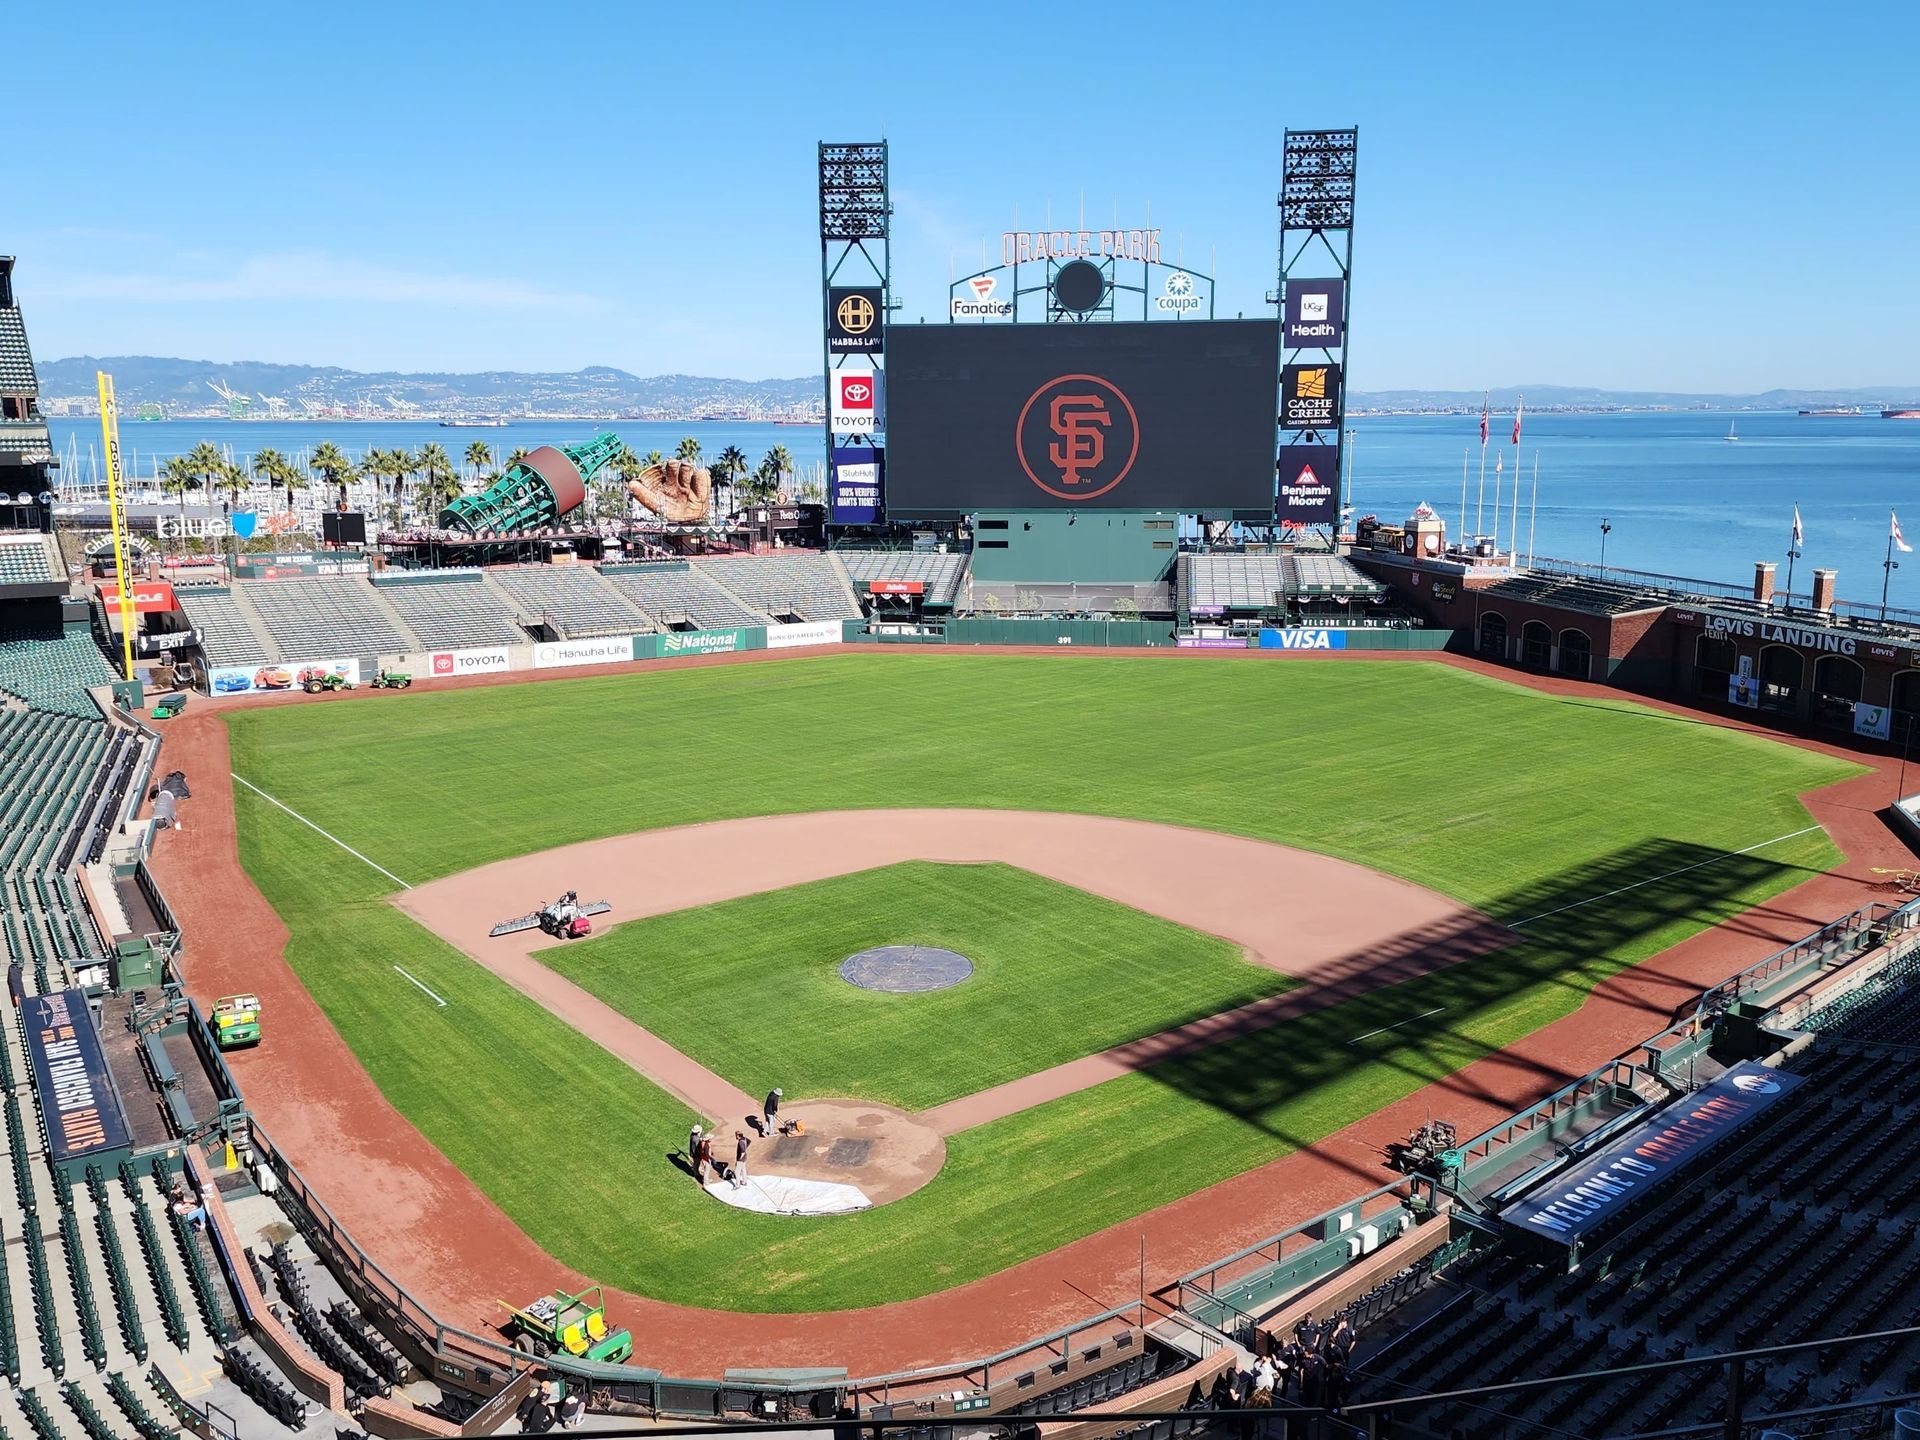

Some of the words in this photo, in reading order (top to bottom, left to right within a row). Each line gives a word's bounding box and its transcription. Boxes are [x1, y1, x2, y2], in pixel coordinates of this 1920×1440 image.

[1002, 233, 1091, 266] ORACLE
[1099, 230, 1162, 264] PARK
[953, 301, 1013, 315] Fanatics
[1159, 296, 1198, 310] coupa
[1303, 302, 1325, 313] UCSF
[1291, 324, 1336, 337] Health
[831, 338, 862, 346] HABBAS
[864, 338, 881, 346] LAW
[1287, 399, 1333, 409] CACHE
[1288, 409, 1331, 418] CREEK
[834, 416, 881, 427] TOYOTA
[111, 440, 120, 482] ROOT
[842, 469, 874, 478] StubHub
[1281, 485, 1332, 498] Benjamin
[837, 497, 857, 507] GIANTS
[858, 497, 881, 507] TICKETS
[156, 514, 228, 539] blue
[318, 563, 338, 575] FAN
[340, 562, 370, 574] ZONE
[1303, 619, 1340, 627] WELCOME
[151, 630, 192, 642] EMERGENCY
[682, 631, 738, 649] National
[798, 631, 825, 640] AMERICA
[1057, 636, 1072, 645] 391
[1276, 630, 1331, 649] VISA
[1704, 615, 1754, 637] Levi's
[1760, 624, 1857, 656] LANDING
[160, 637, 184, 650] EXIT
[715, 645, 735, 653] Rental
[559, 649, 605, 660] Hanwha
[607, 646, 629, 656] Life
[458, 655, 506, 668] TOYOTA
[44, 1040, 81, 1060] SAN
[48, 1057, 95, 1111] FRANCISCO
[61, 1109, 106, 1150] GIANTS
[1528, 1171, 1635, 1232] WELCOME
[1610, 1157, 1657, 1177] TO
[1635, 1119, 1707, 1162] ORACLE
[1690, 1095, 1751, 1126] PARK
